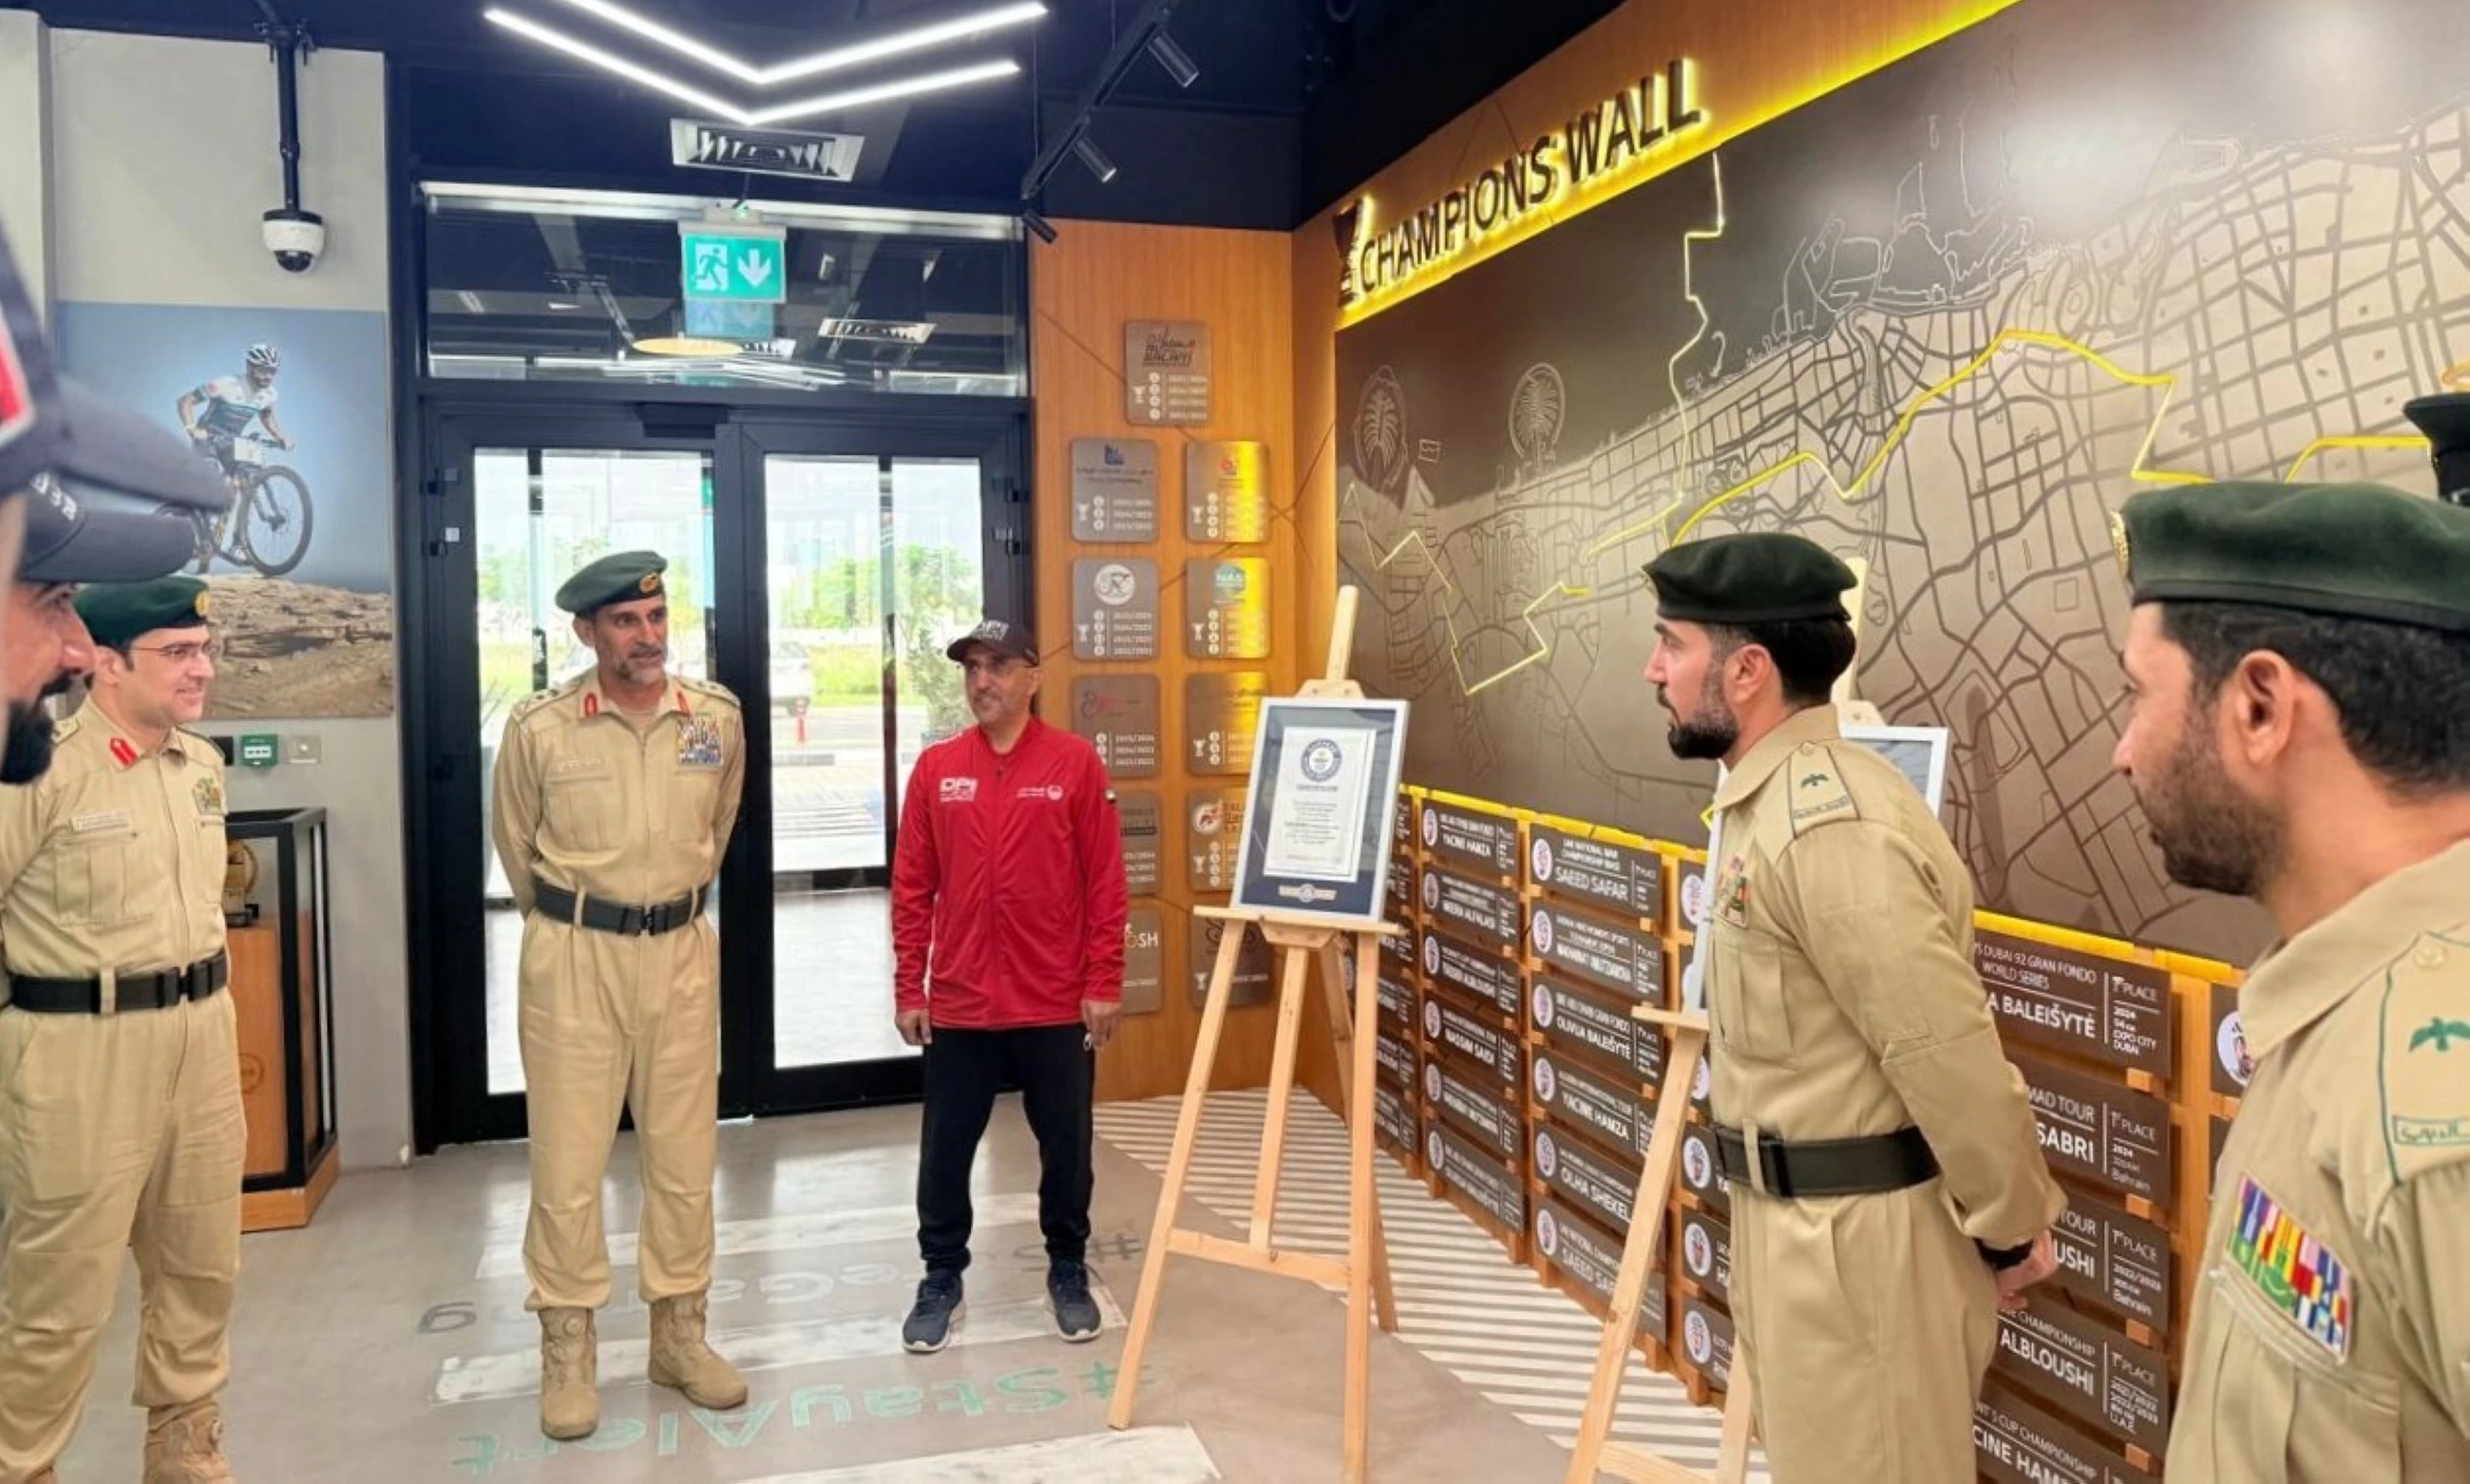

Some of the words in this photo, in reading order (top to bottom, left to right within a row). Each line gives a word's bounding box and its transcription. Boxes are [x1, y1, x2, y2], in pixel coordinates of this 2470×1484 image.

[1359, 134, 1560, 293] CHAMPIONS
[1566, 58, 1708, 184] WALL
[1555, 866, 1590, 893] SAEED
[1590, 875, 1629, 902] SAFAR
[1983, 961, 2017, 981] WORLD
[2020, 970, 2050, 990] SERIES
[2027, 955, 2057, 973] GRAN
[2058, 961, 2098, 984] FONDO
[2124, 982, 2158, 1002] PLACE
[2003, 995, 2096, 1038] BALEIŠYTĖ
[1562, 1092, 1594, 1124] YACINE
[1594, 1106, 1630, 1141] HAMZA
[2058, 1094, 2096, 1124] TOUR
[2036, 1121, 2095, 1165] SABRI
[2121, 1116, 2156, 1142] PLACE
[1561, 1166, 1591, 1197] OLHA
[1561, 1247, 1594, 1281] SAEED
[2124, 1235, 2157, 1264] PLACE
[2019, 1310, 2096, 1358] CHAMPIONSHIP
[2000, 1328, 2095, 1398] ALBLOUSHI
[1998, 1412, 2020, 1432] CUP
[2020, 1424, 2098, 1479] CHAMPIONSHIP
